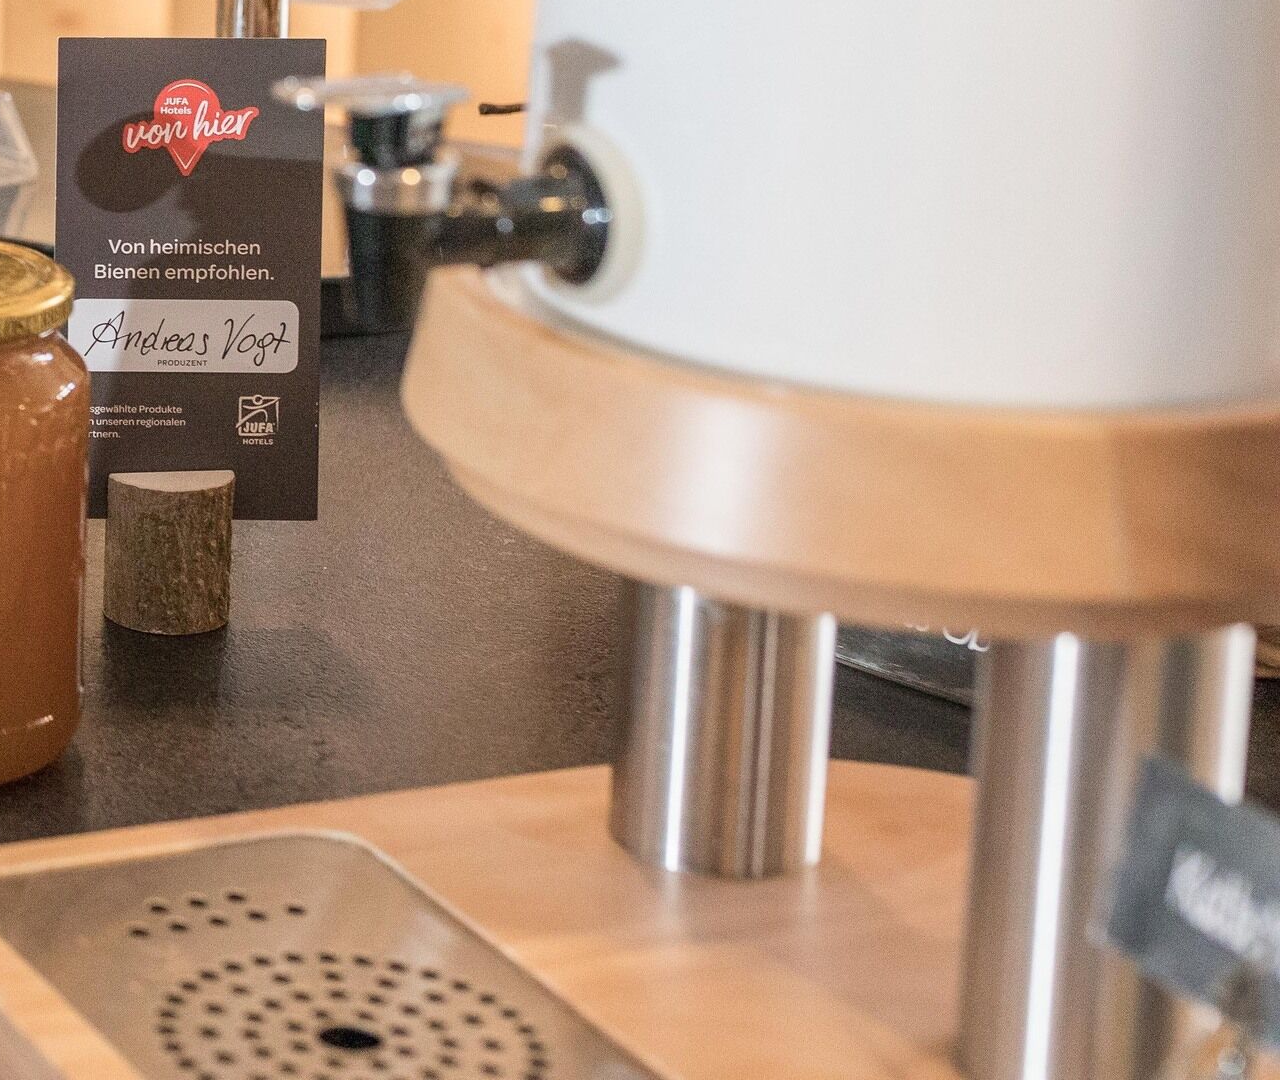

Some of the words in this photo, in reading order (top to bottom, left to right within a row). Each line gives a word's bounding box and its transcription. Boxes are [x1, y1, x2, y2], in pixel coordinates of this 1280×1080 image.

[163, 97, 189, 106] JUFA
[160, 106, 192, 115] Hotels
[126, 121, 188, 149] von
[193, 100, 254, 140] hier
[108, 239, 145, 255] Von
[150, 239, 262, 255] heimischen
[94, 264, 160, 280] Bienen
[165, 265, 275, 283] empfohlen.
[84, 311, 210, 356] Andreas
[222, 314, 291, 366] Vogt
[157, 359, 208, 367] PRODUZENT
[90, 404, 138, 416] sgewählte
[139, 405, 183, 414] Produkte
[96, 418, 135, 426] unseren
[137, 418, 186, 428] regionalen
[243, 422, 275, 433] JUFA
[88, 430, 121, 438] rtnern.
